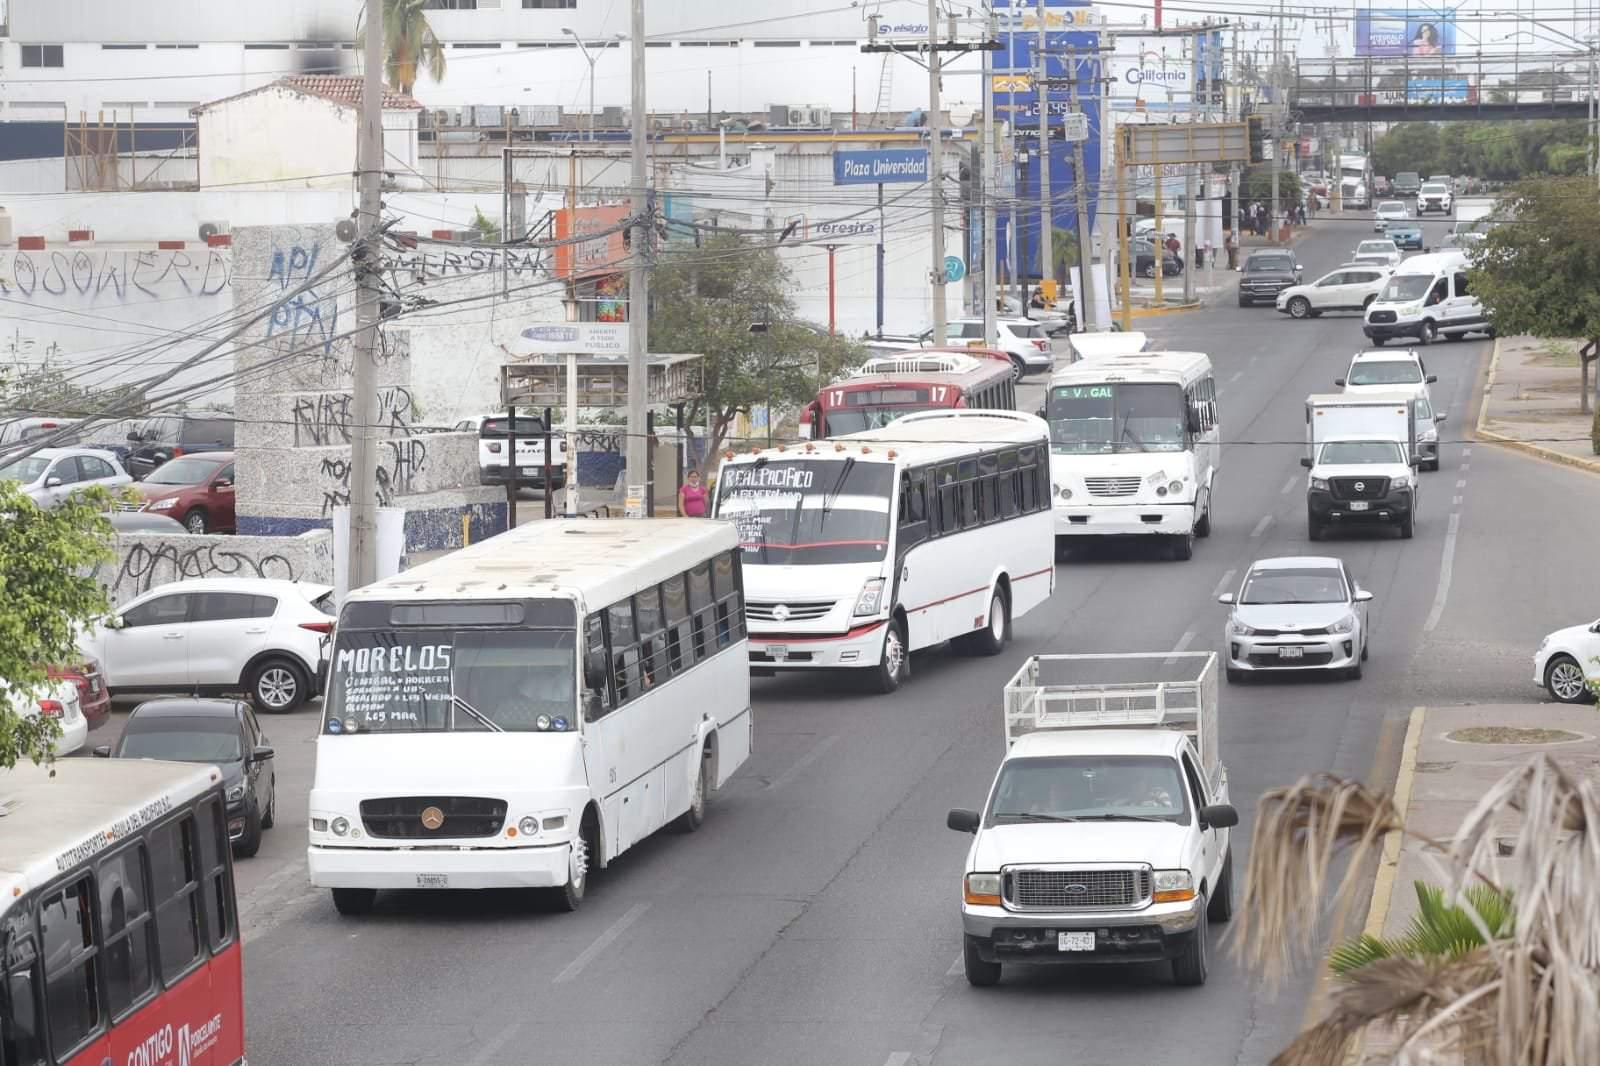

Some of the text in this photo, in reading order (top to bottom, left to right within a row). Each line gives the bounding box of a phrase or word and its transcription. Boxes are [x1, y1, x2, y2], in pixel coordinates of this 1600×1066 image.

[1126, 68, 1186, 84] California
[844, 156, 925, 177] Plaza Universidad
[830, 391, 844, 407] 17
[931, 386, 947, 402] 17
[337, 645, 453, 673] MORELOS
